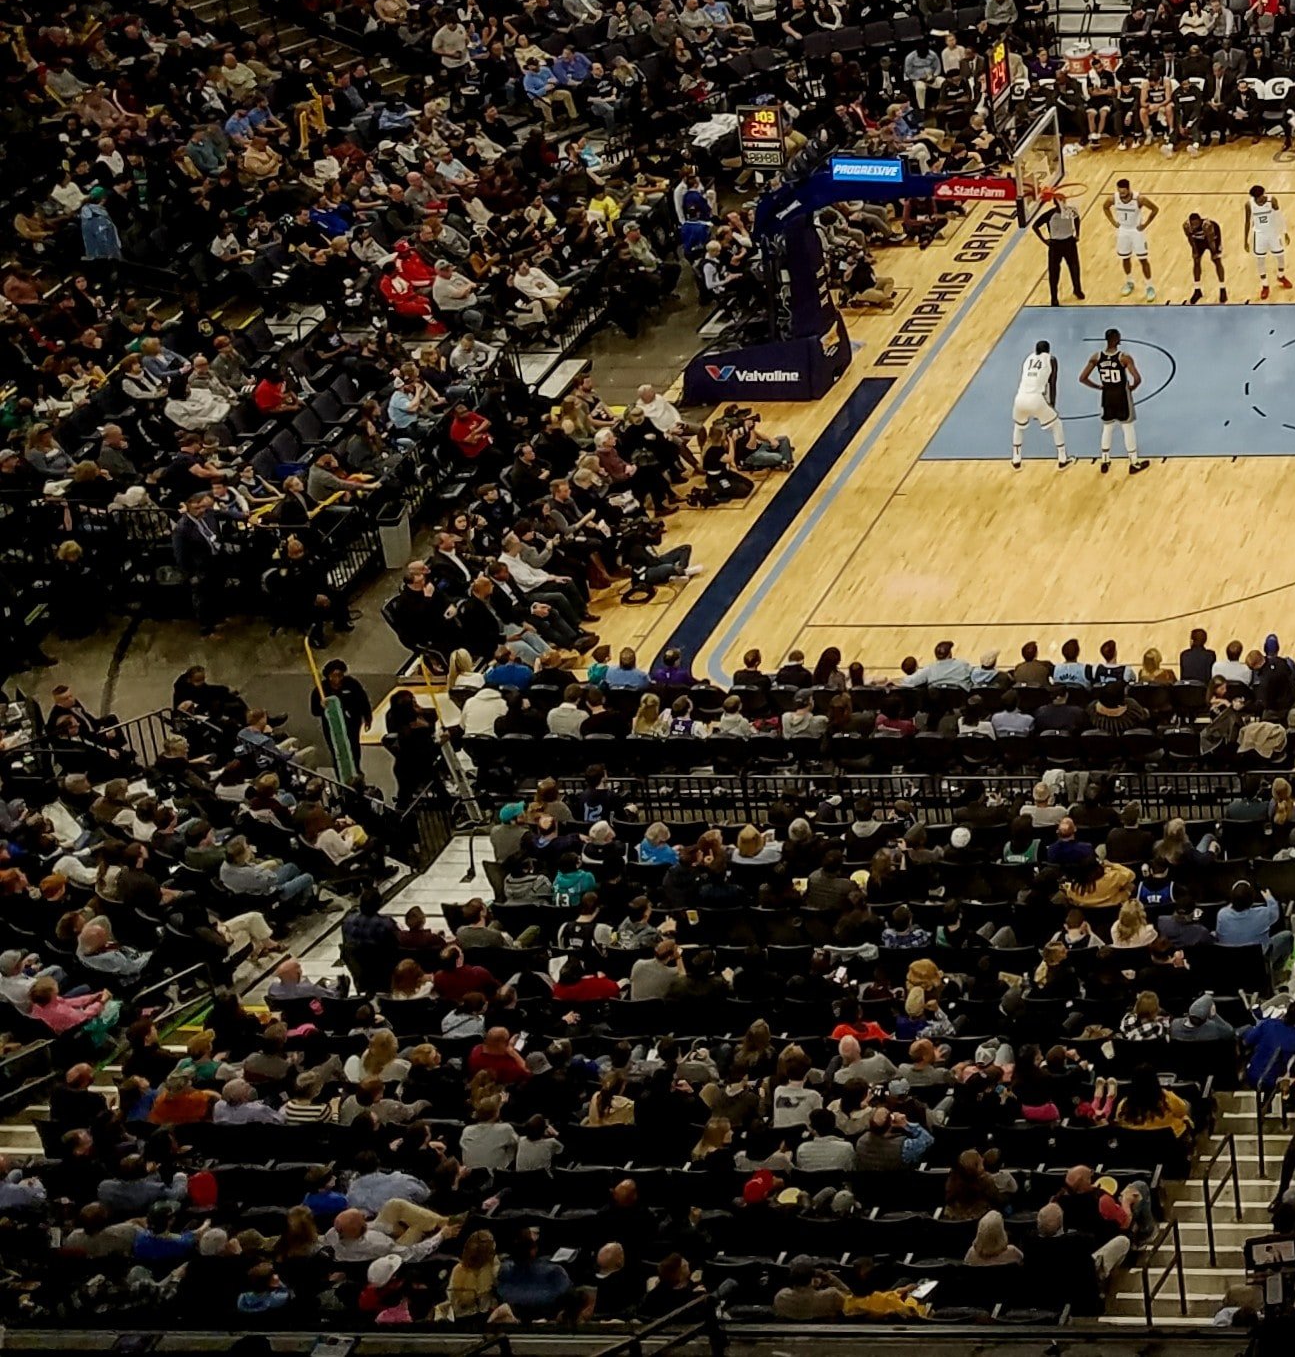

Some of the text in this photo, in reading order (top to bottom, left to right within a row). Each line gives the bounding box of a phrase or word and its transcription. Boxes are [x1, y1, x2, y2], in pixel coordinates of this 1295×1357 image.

[833, 164, 900, 176] PROGRESSIVE
[873, 272, 974, 367] MEMPHIS
[1027, 359, 1043, 371] 14
[735, 370, 800, 382] Valvoline
[1100, 369, 1121, 384] 20
[555, 892, 570, 908] 13
